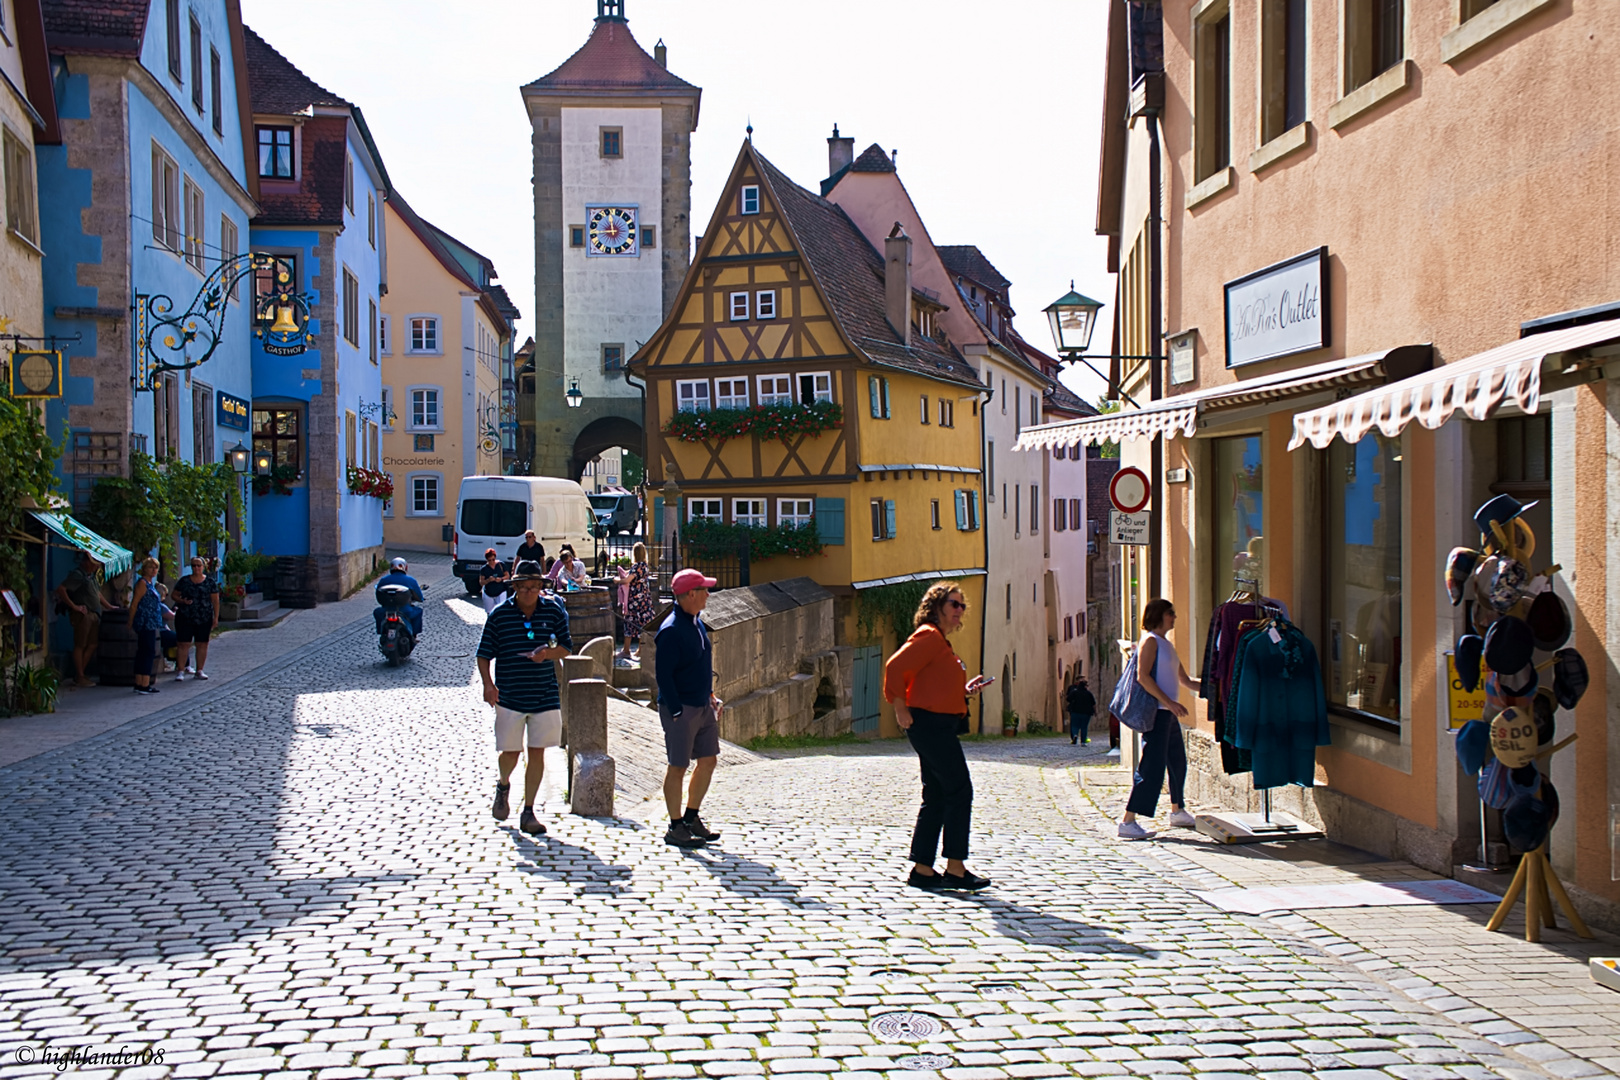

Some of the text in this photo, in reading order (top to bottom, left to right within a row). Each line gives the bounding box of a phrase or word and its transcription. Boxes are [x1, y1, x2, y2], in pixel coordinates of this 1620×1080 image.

[1279, 282, 1318, 329] Outlet
[266, 345, 302, 355] GASTHOF
[383, 457, 444, 465] Chocolaterie
[1510, 725, 1533, 739] DO
